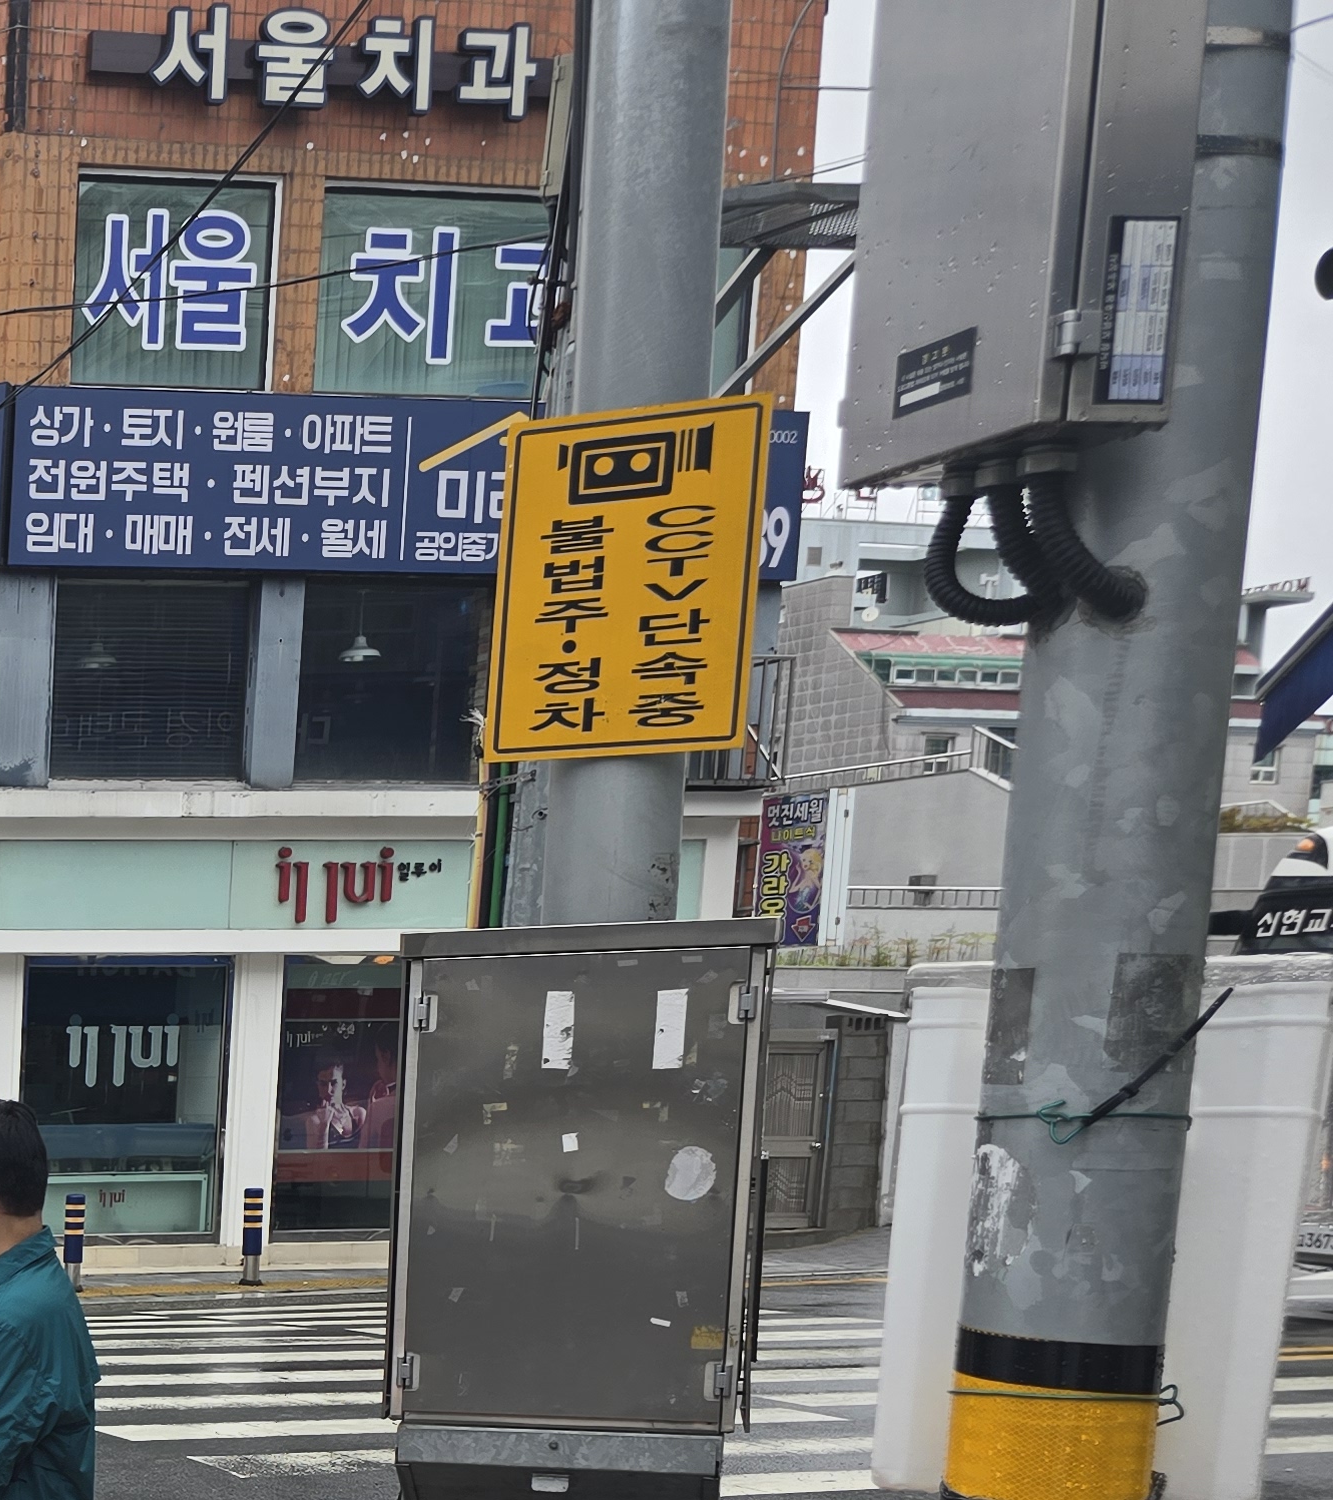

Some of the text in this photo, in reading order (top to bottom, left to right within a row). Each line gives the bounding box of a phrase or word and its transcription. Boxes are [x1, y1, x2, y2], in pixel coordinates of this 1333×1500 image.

[150, 4, 537, 121] 서울치과
[82, 207, 258, 352] 서울
[29, 405, 393, 455] 상가 토지 원룸 아파트
[28, 458, 391, 508] 전원주택 펜션부지
[25, 512, 387, 560] 임대 매매 전세 월세
[529, 515, 615, 732] 불법주·정차
[766, 799, 824, 826] 멋진세월
[770, 826, 817, 843] 나이트식
[397, 858, 443, 881] 일루이
[761, 852, 790, 916] 가라오
[1255, 908, 1333, 938] 신현교
